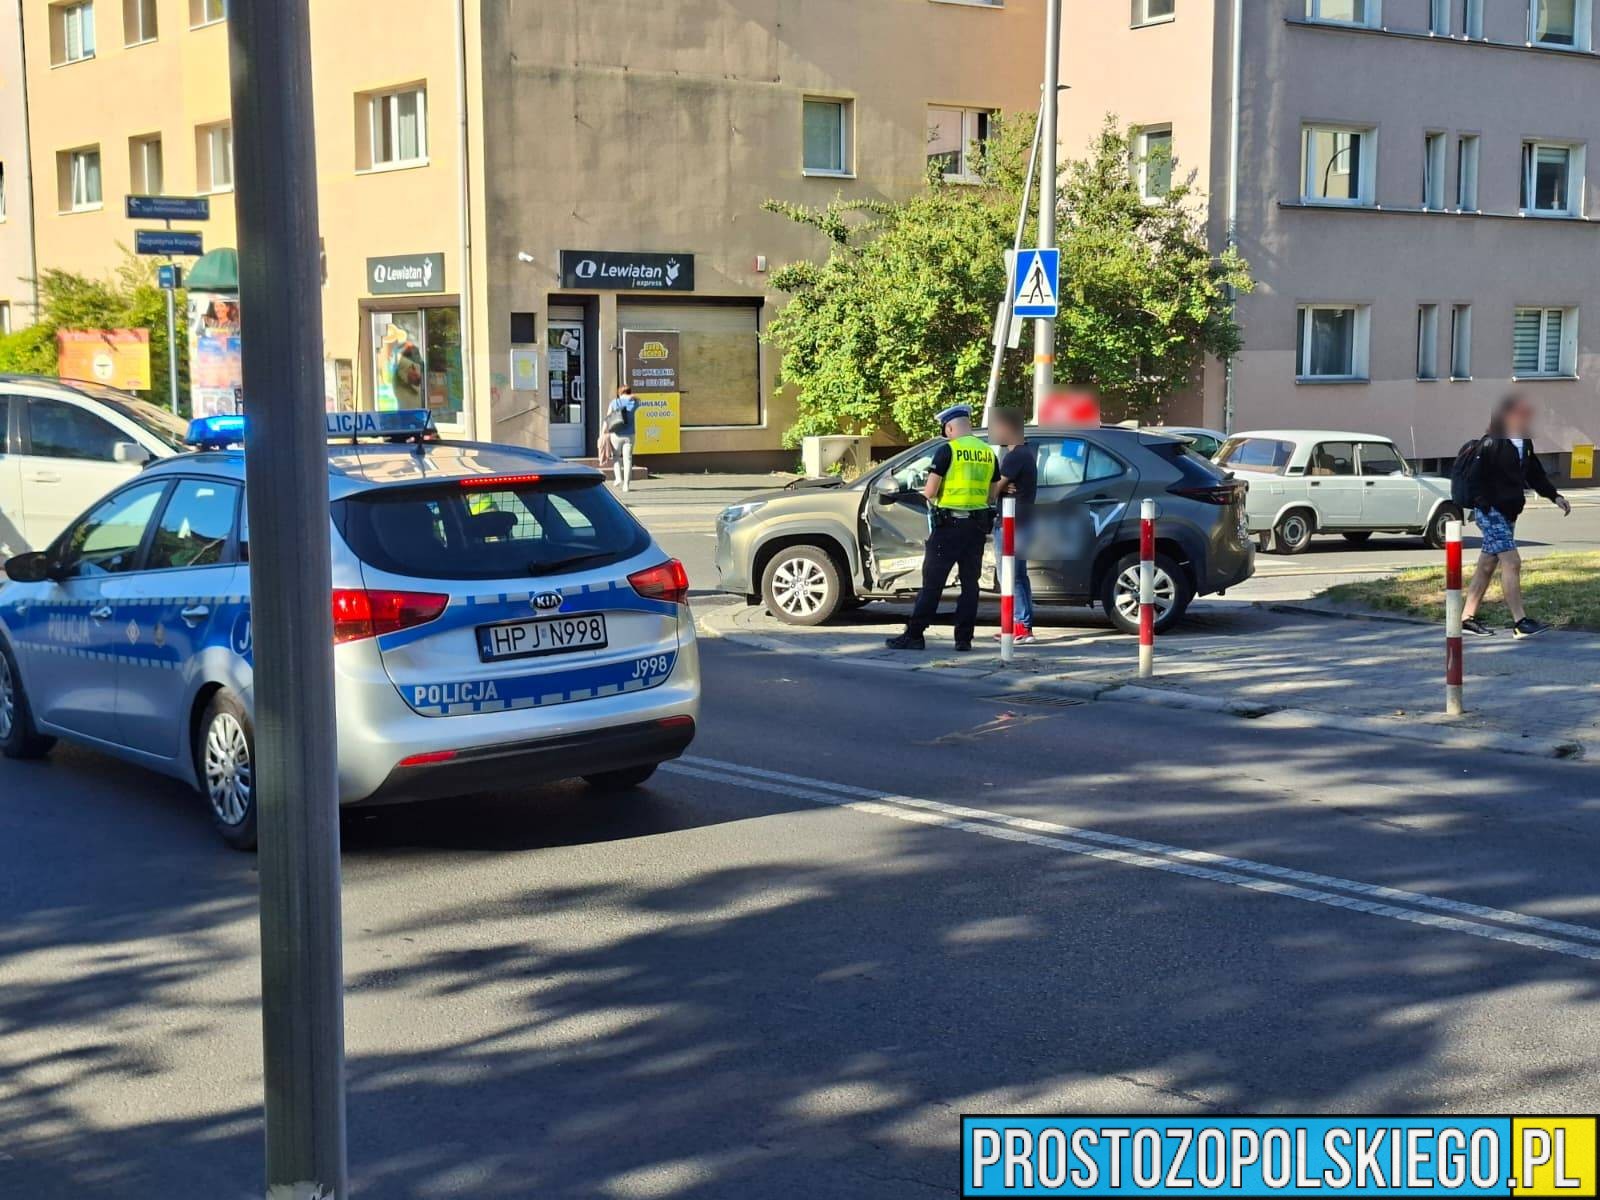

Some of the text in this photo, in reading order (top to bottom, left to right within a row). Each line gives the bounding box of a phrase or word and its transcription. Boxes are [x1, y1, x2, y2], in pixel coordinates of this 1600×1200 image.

[387, 265, 422, 280] Lewiatan
[600, 262, 663, 278] Lewiatan
[326, 413, 377, 433] LICJA
[956, 450, 993, 463] POLICJA
[536, 595, 558, 607] KIA
[632, 655, 668, 679] J998
[414, 681, 498, 705] POLICJA
